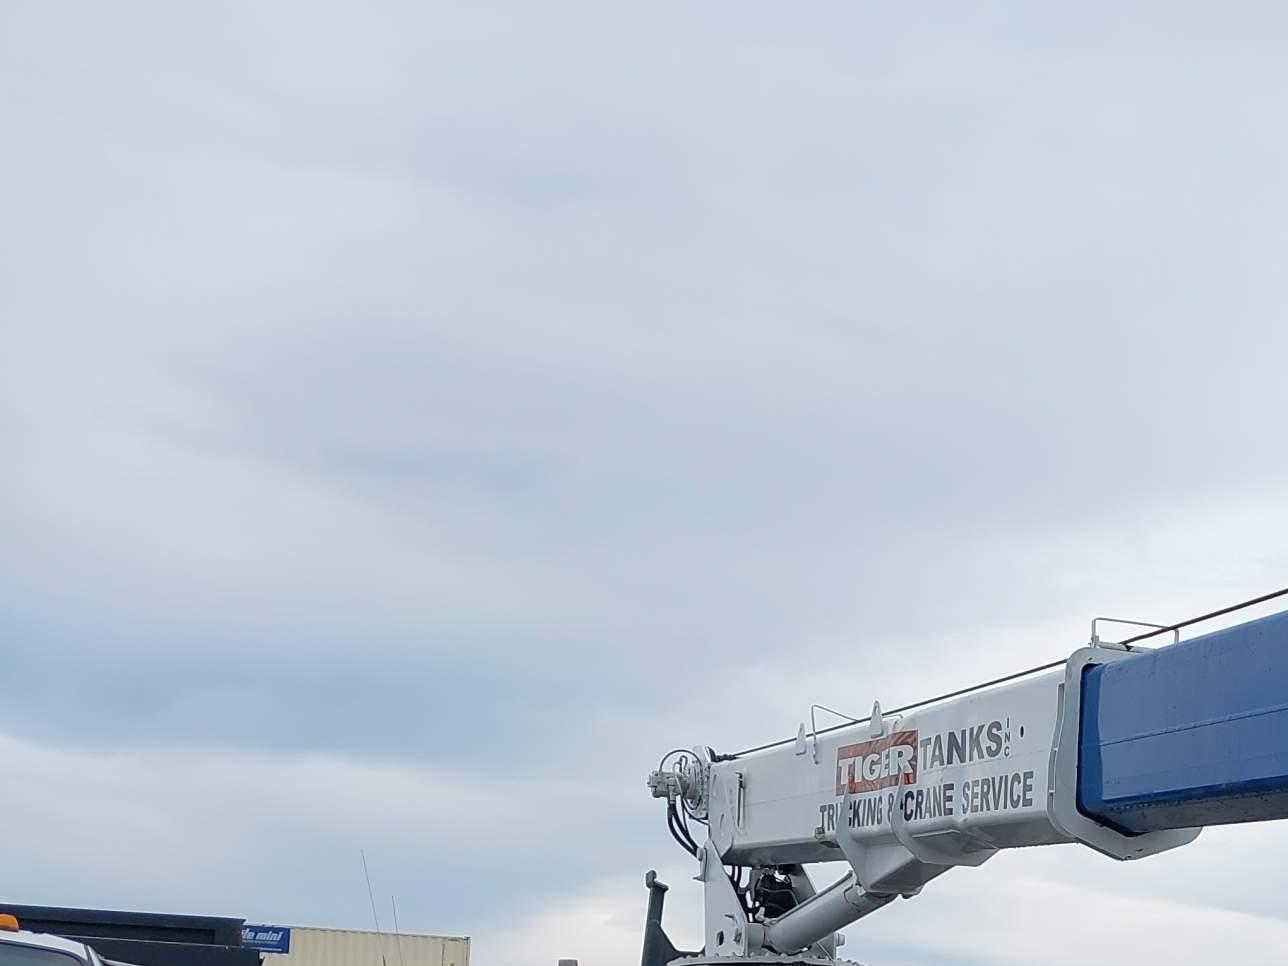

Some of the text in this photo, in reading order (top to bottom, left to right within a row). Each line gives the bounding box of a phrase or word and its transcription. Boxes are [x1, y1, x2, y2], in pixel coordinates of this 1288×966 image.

[838, 720, 1003, 785] TIGER TANKS
[904, 783, 955, 822] CRANE
[962, 770, 1034, 815] SERVICE
